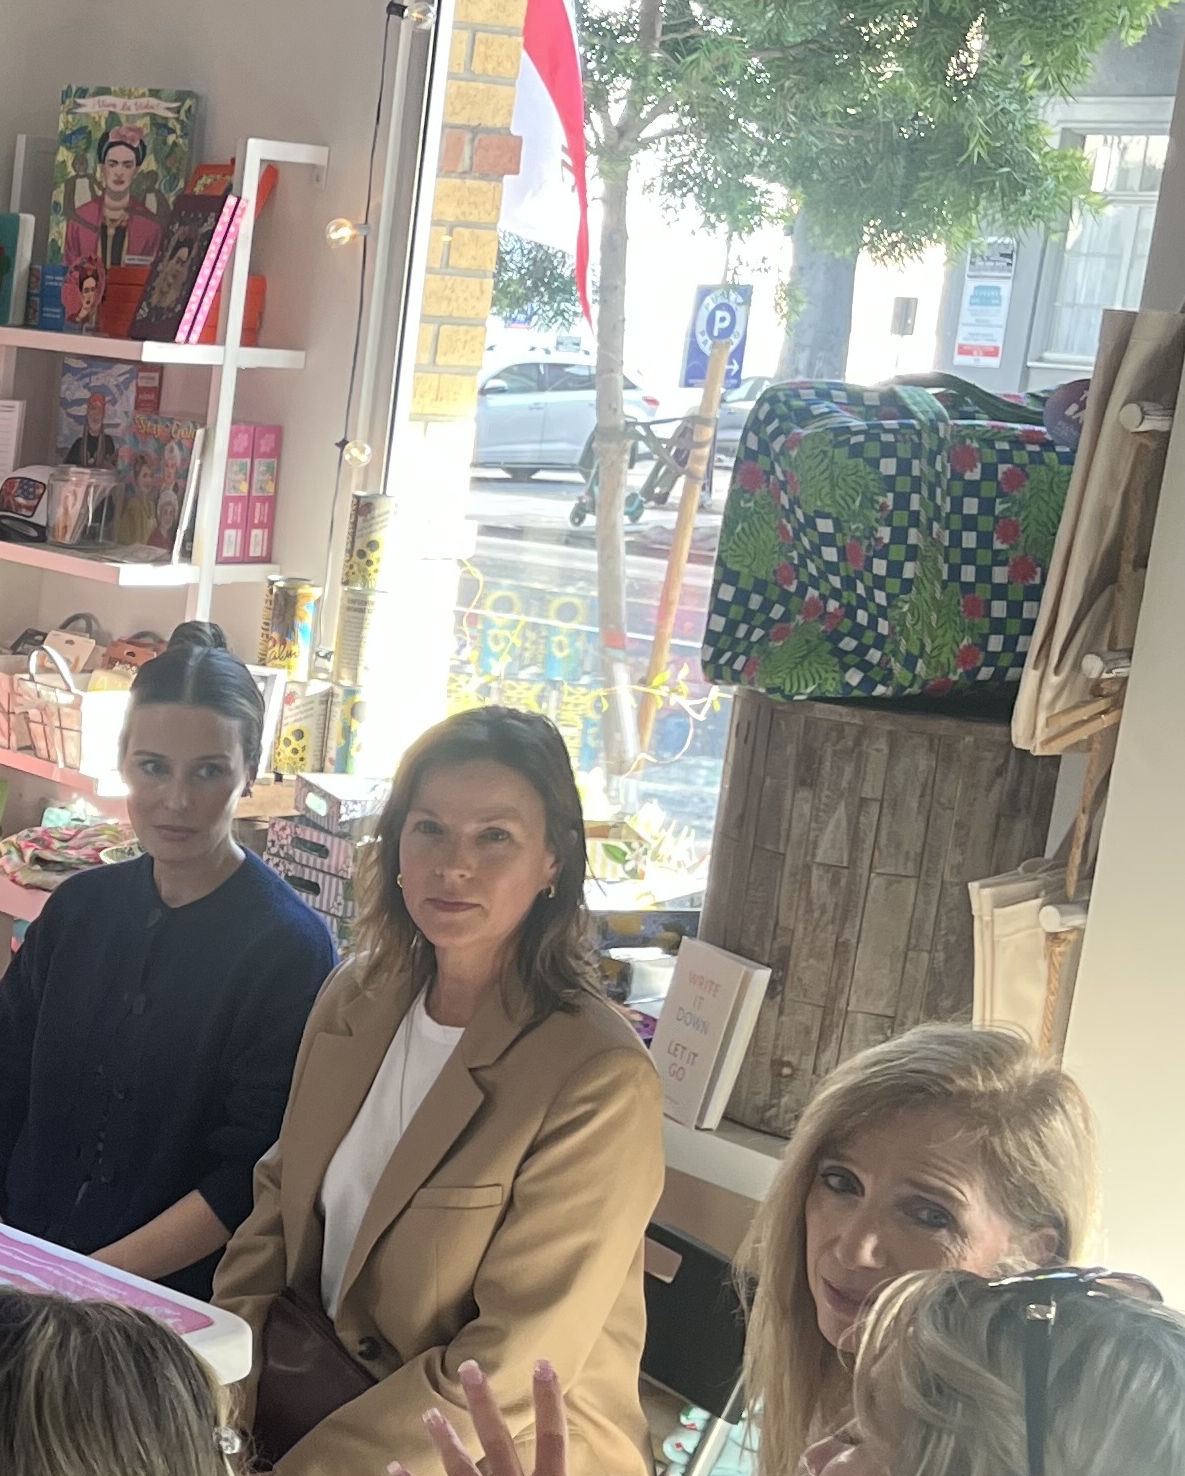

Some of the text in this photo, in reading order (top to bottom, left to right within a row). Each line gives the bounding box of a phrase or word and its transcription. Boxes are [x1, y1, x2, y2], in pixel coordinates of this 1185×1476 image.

[712, 310, 731, 336] P
[688, 971, 721, 998] WRITE
[693, 996, 705, 1010] IT
[676, 1007, 711, 1036] DOWN
[667, 1039, 698, 1068] LET IT
[668, 1063, 686, 1082] GO
